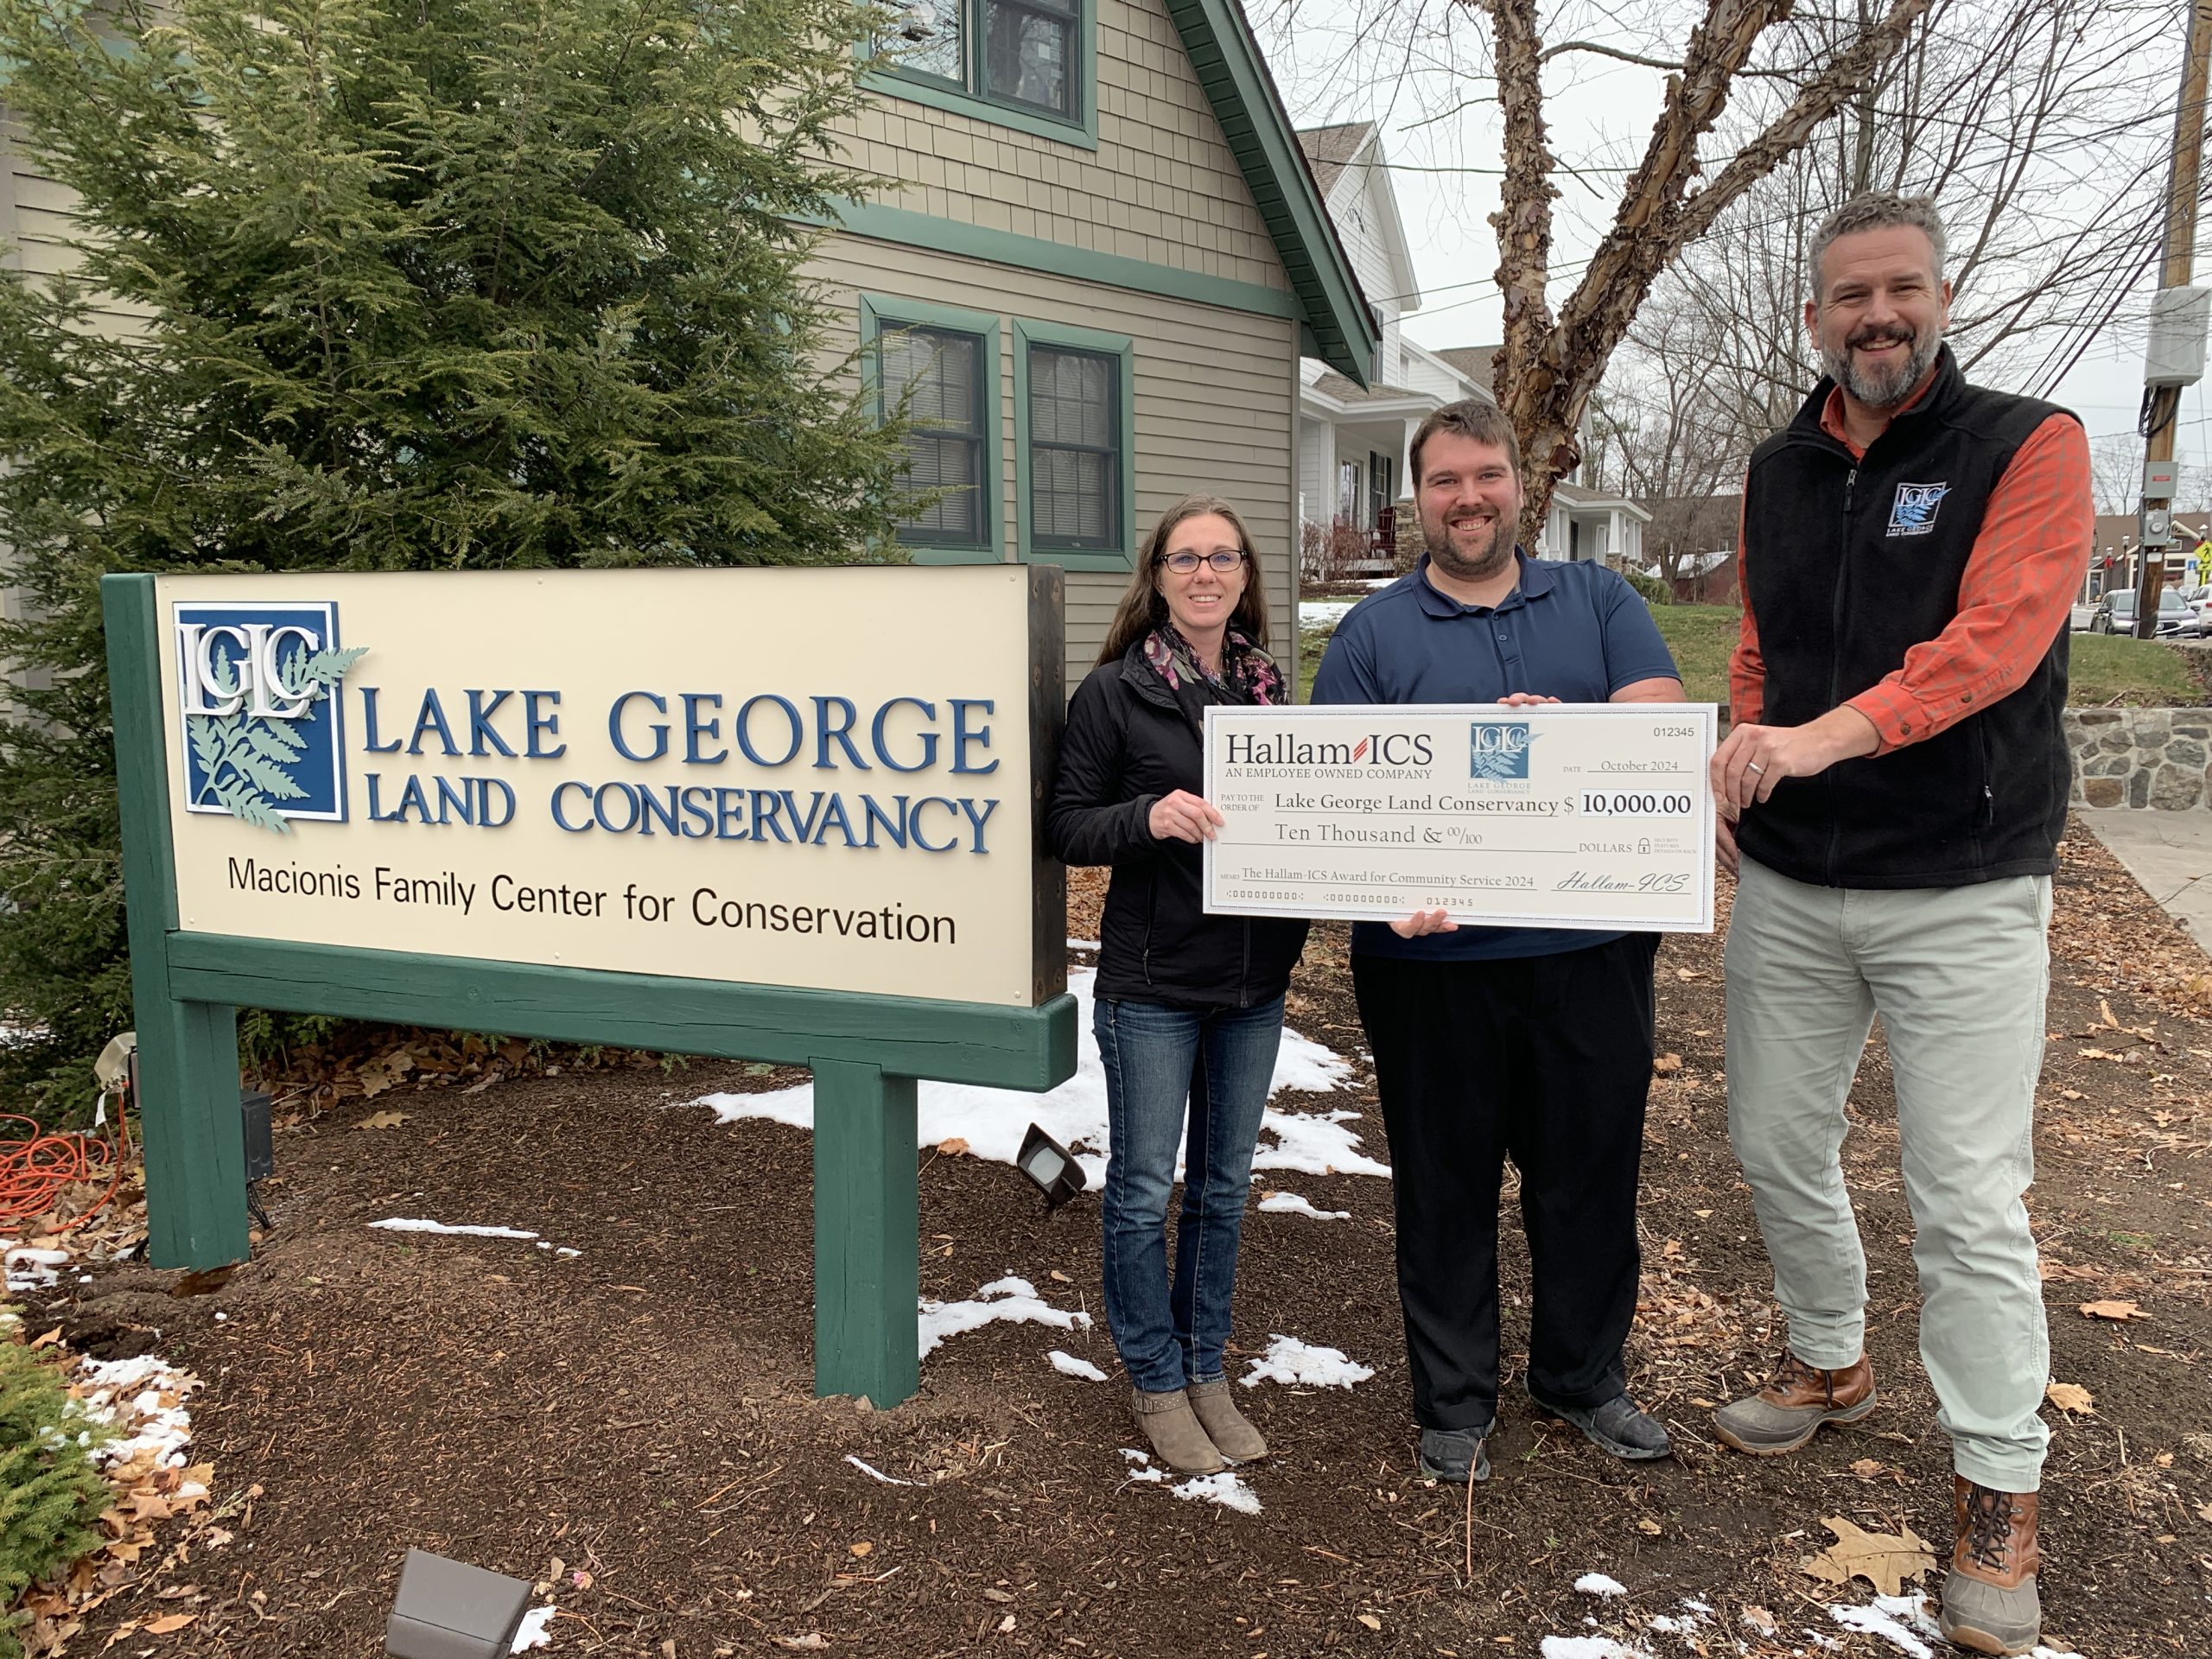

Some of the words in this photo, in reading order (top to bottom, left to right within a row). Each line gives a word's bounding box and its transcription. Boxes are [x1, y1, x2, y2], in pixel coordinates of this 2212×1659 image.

[175, 622, 320, 719] LGLC
[359, 687, 567, 758] LAKE
[608, 691, 1000, 774] GEORGE
[1653, 727, 1694, 737] 012345
[1225, 733, 1352, 765] Hallam
[1368, 734, 1433, 766] ICS
[1225, 767, 1243, 778] AN
[1246, 767, 1311, 779] EMPLOYEE
[1314, 768, 1363, 779] OWNED
[1366, 768, 1433, 779] COMPANY
[1601, 760, 1647, 771] October
[1650, 760, 1678, 771] 2024
[364, 773, 517, 827] LAND
[550, 781, 1000, 854] CONSERVANCY
[1275, 793, 1315, 808] Lake
[1320, 794, 1382, 814] George
[1388, 795, 1432, 810] Land
[1439, 796, 1559, 817] Conservancy
[1563, 795, 1574, 815] $
[1583, 794, 1691, 816] 10,000.00
[1274, 823, 1311, 841] Ten
[1317, 823, 1415, 843] Thousand
[1422, 827, 1443, 843] &
[1579, 842, 1632, 853] DOLLARS
[1242, 867, 1262, 878] The
[1265, 868, 1327, 880] Hallam-ICS
[1330, 870, 1367, 881] Award
[1370, 872, 1386, 882] for
[1389, 872, 1456, 887] Community
[1459, 874, 1502, 886] Service
[1505, 875, 1534, 887] 2024
[228, 856, 360, 899] Macionis
[375, 867, 476, 916] Family
[491, 874, 607, 917] Center
[623, 884, 676, 922] for
[691, 887, 956, 944] Conservation
[1427, 897, 1473, 906] 012345
